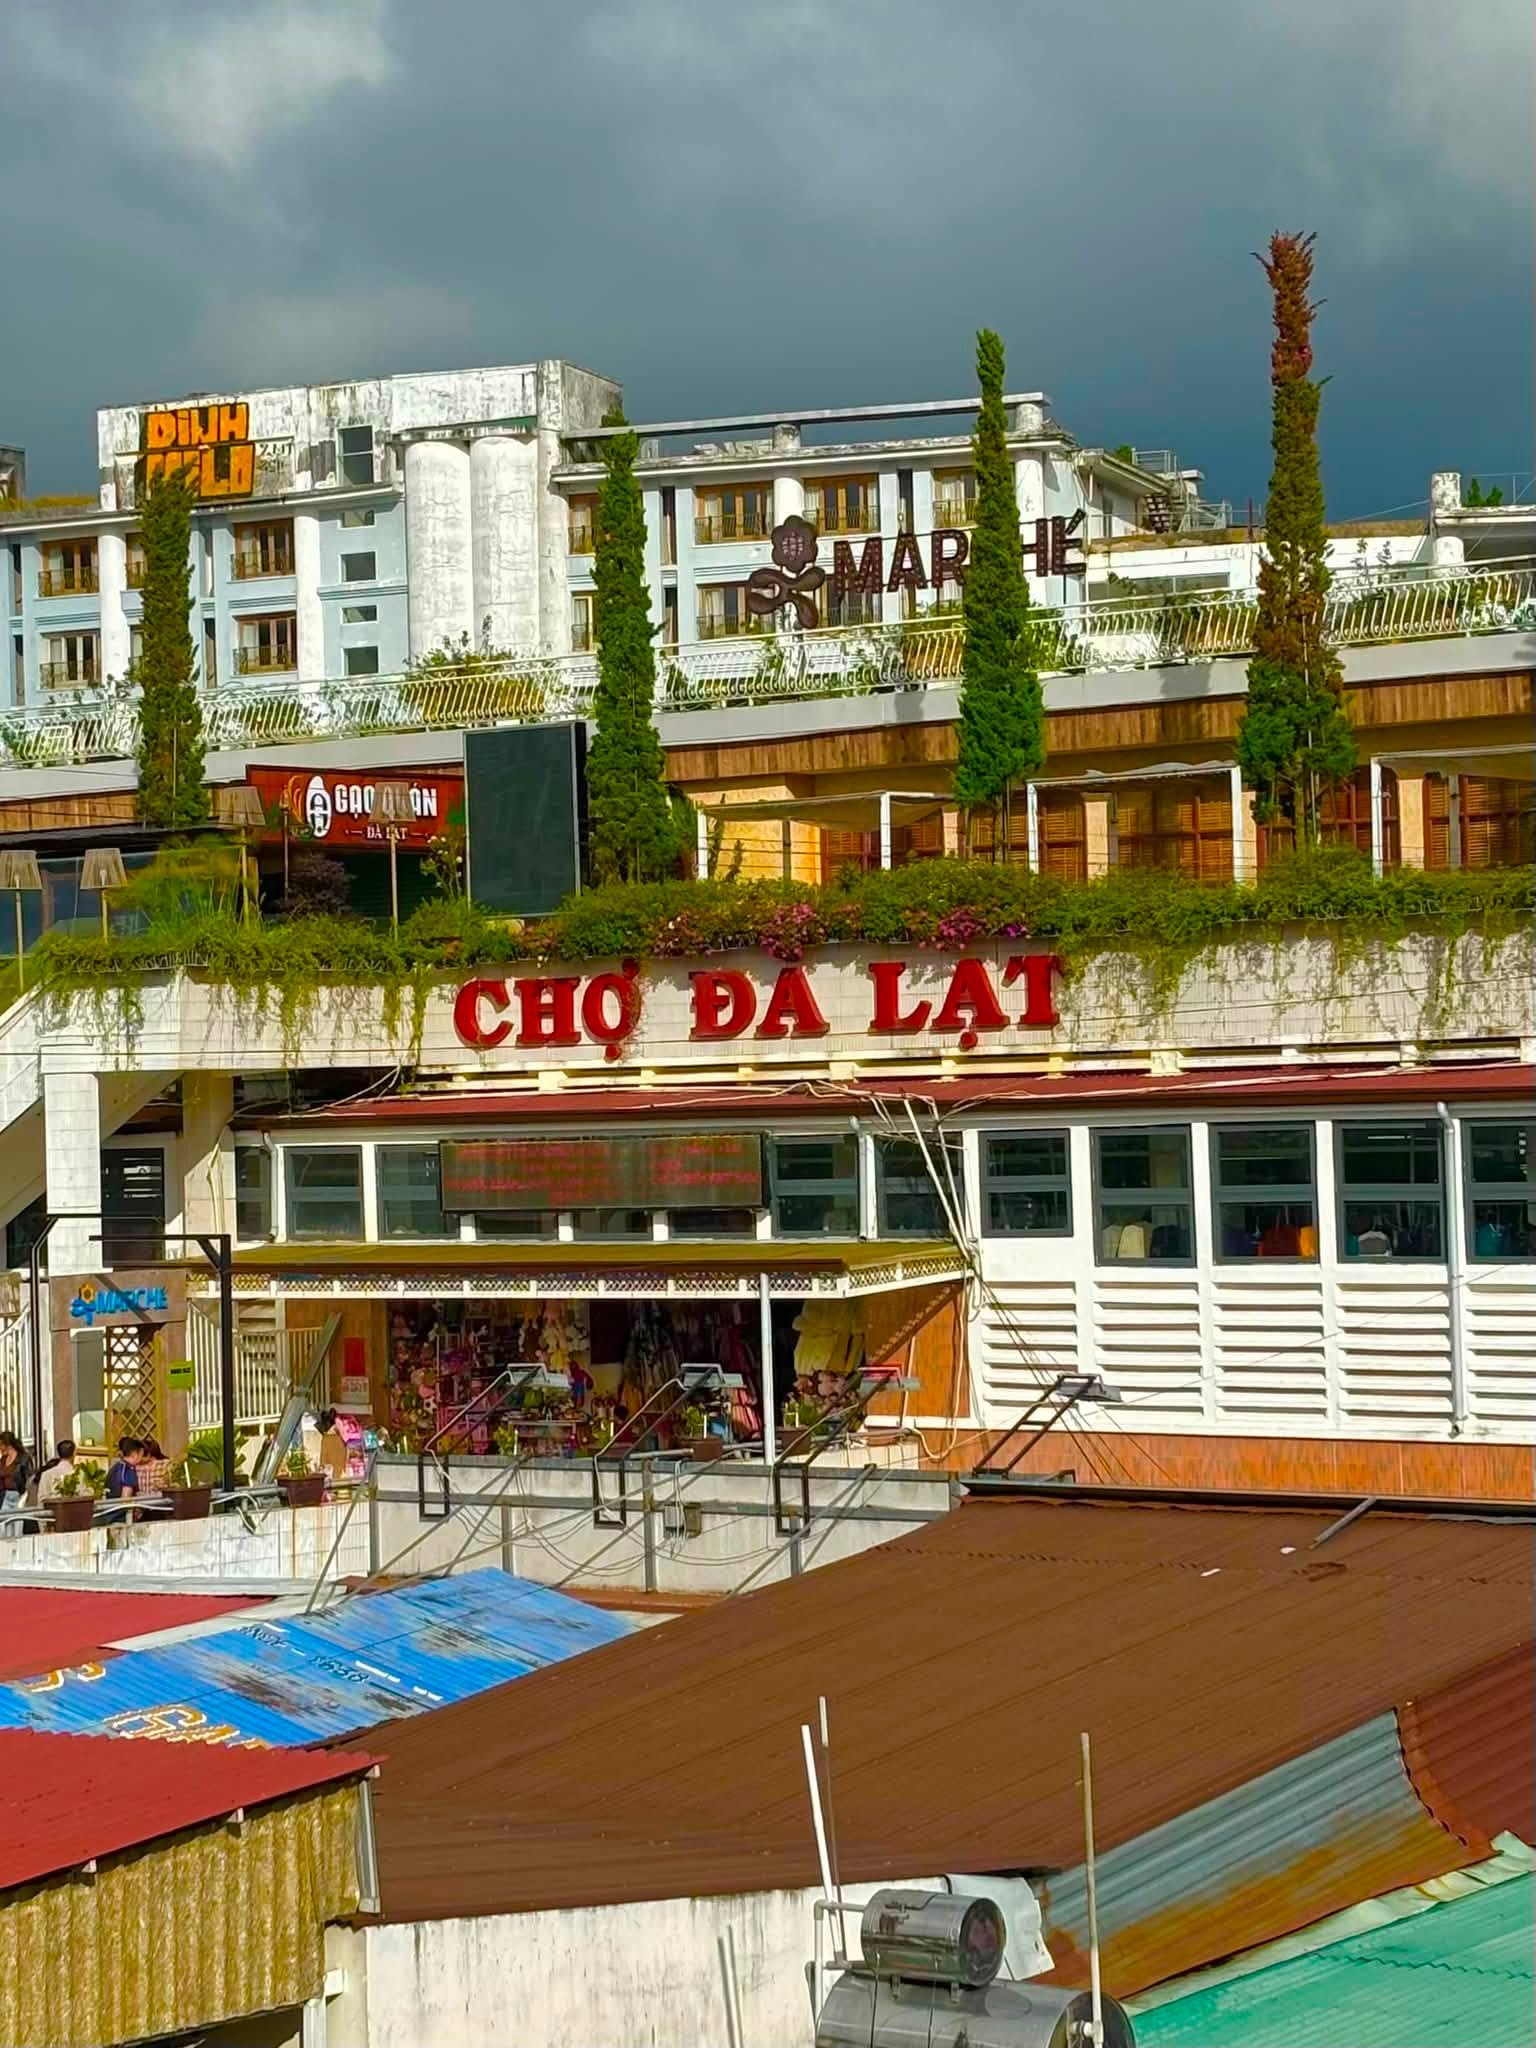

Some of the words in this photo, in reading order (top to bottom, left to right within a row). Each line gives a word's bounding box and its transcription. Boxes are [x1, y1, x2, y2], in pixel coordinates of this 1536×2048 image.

[833, 508, 1087, 594] MARHÉ
[453, 956, 642, 1064] CHỢ
[867, 954, 1066, 1050] LẠT
